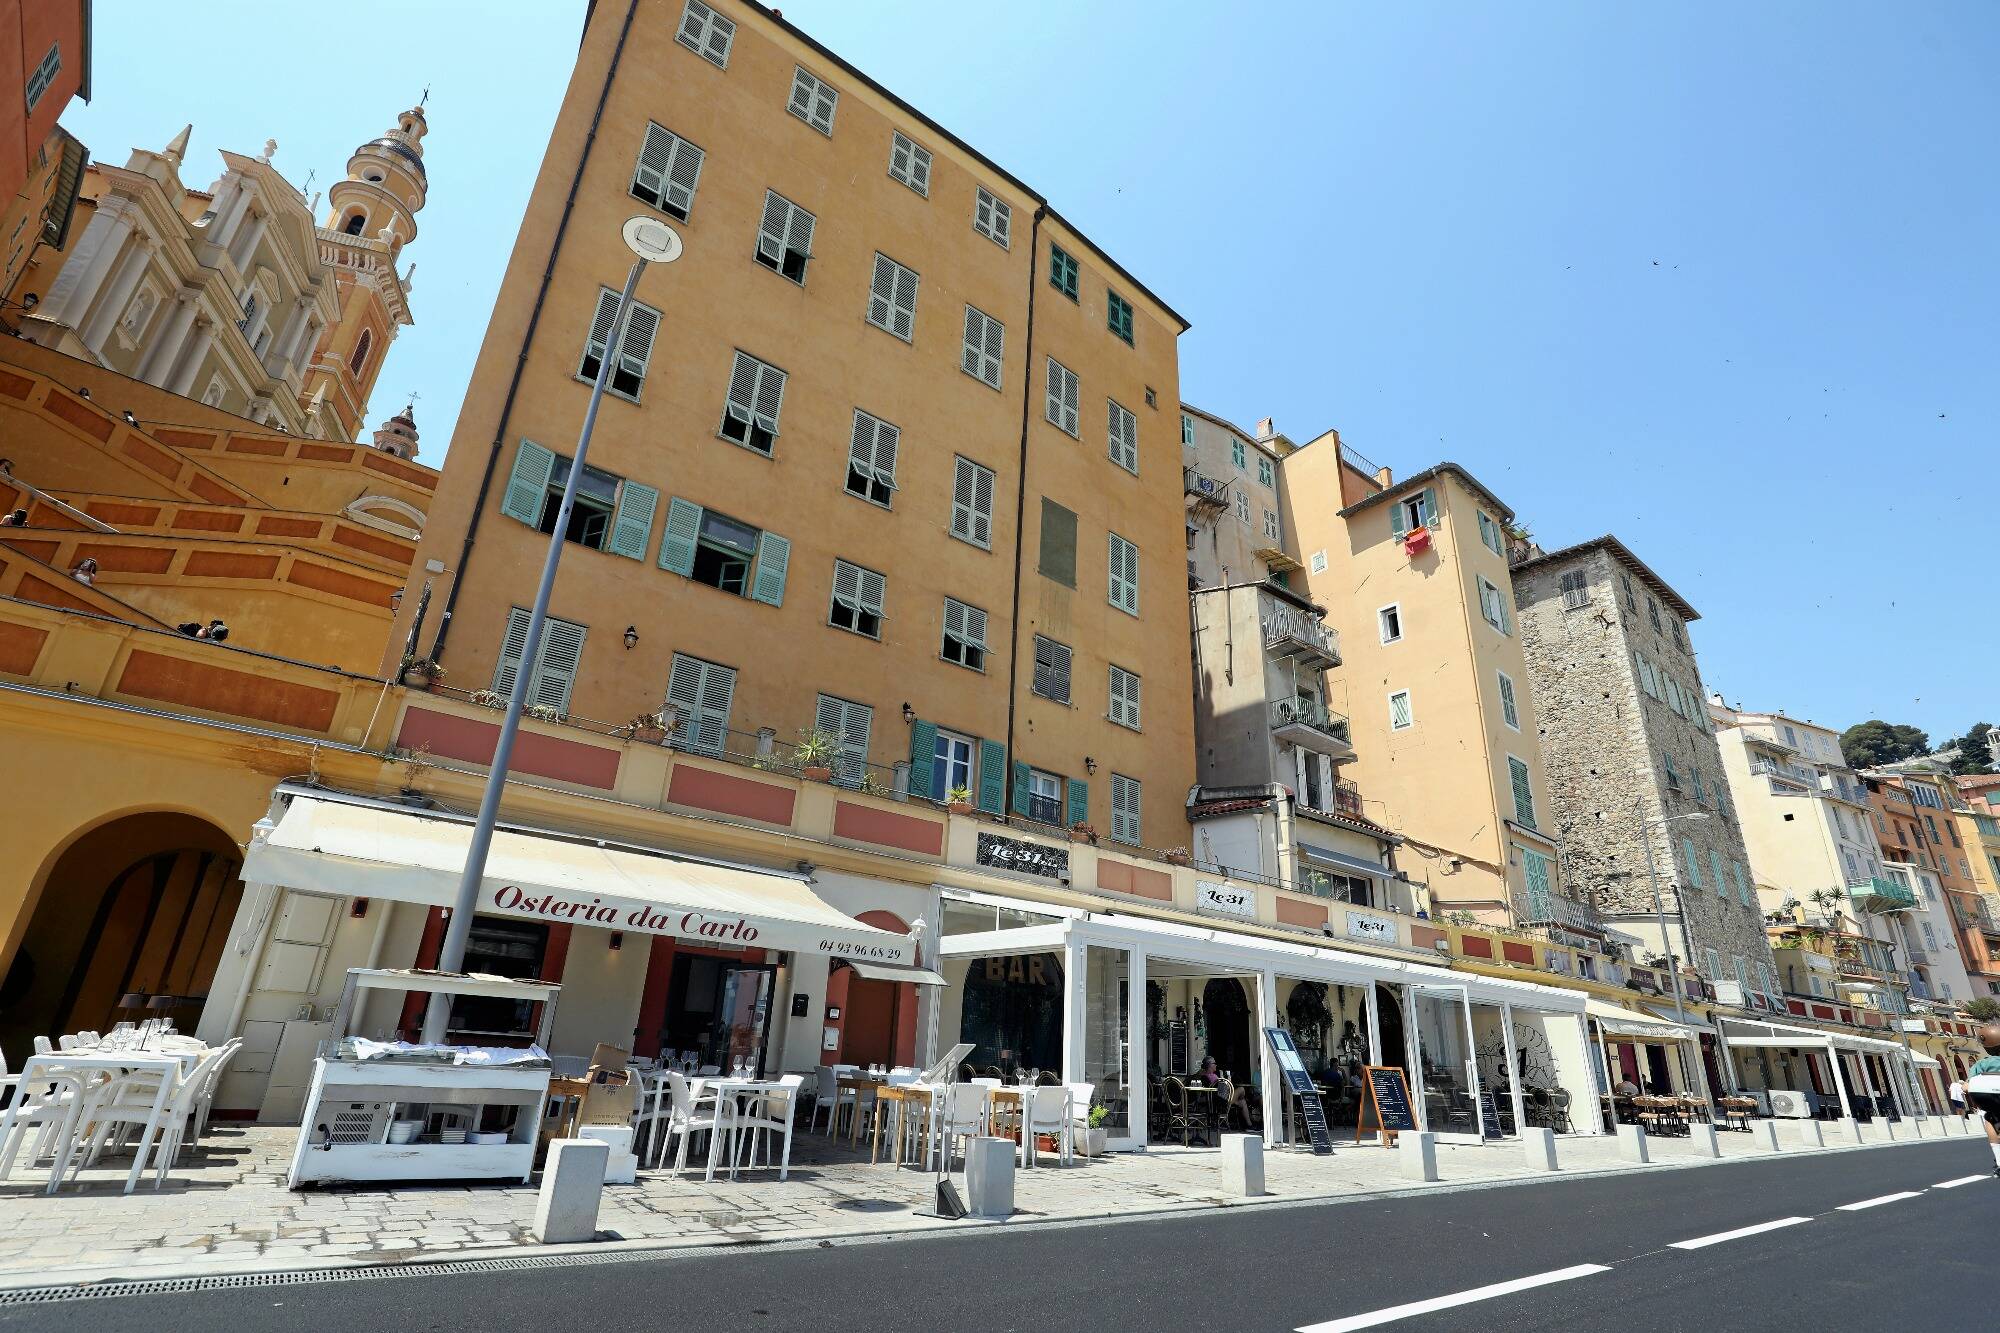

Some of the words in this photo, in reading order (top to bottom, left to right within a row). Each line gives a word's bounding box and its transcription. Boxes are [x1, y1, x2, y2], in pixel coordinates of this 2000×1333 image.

[989, 844, 1013, 861] Le
[1016, 850, 1042, 864] 31
[1207, 890, 1223, 903] Le
[1226, 894, 1245, 906] 31
[494, 885, 617, 923] Osteria
[627, 906, 669, 930] da
[680, 912, 759, 942] Carlo
[1357, 920, 1371, 931] Le
[1373, 922, 1385, 932] 31
[819, 939, 834, 951] 04
[837, 942, 852, 954] 93
[854, 944, 867, 956] 96
[870, 946, 885, 958] 68
[887, 948, 901, 960] 29
[985, 955, 1047, 985] BAR
